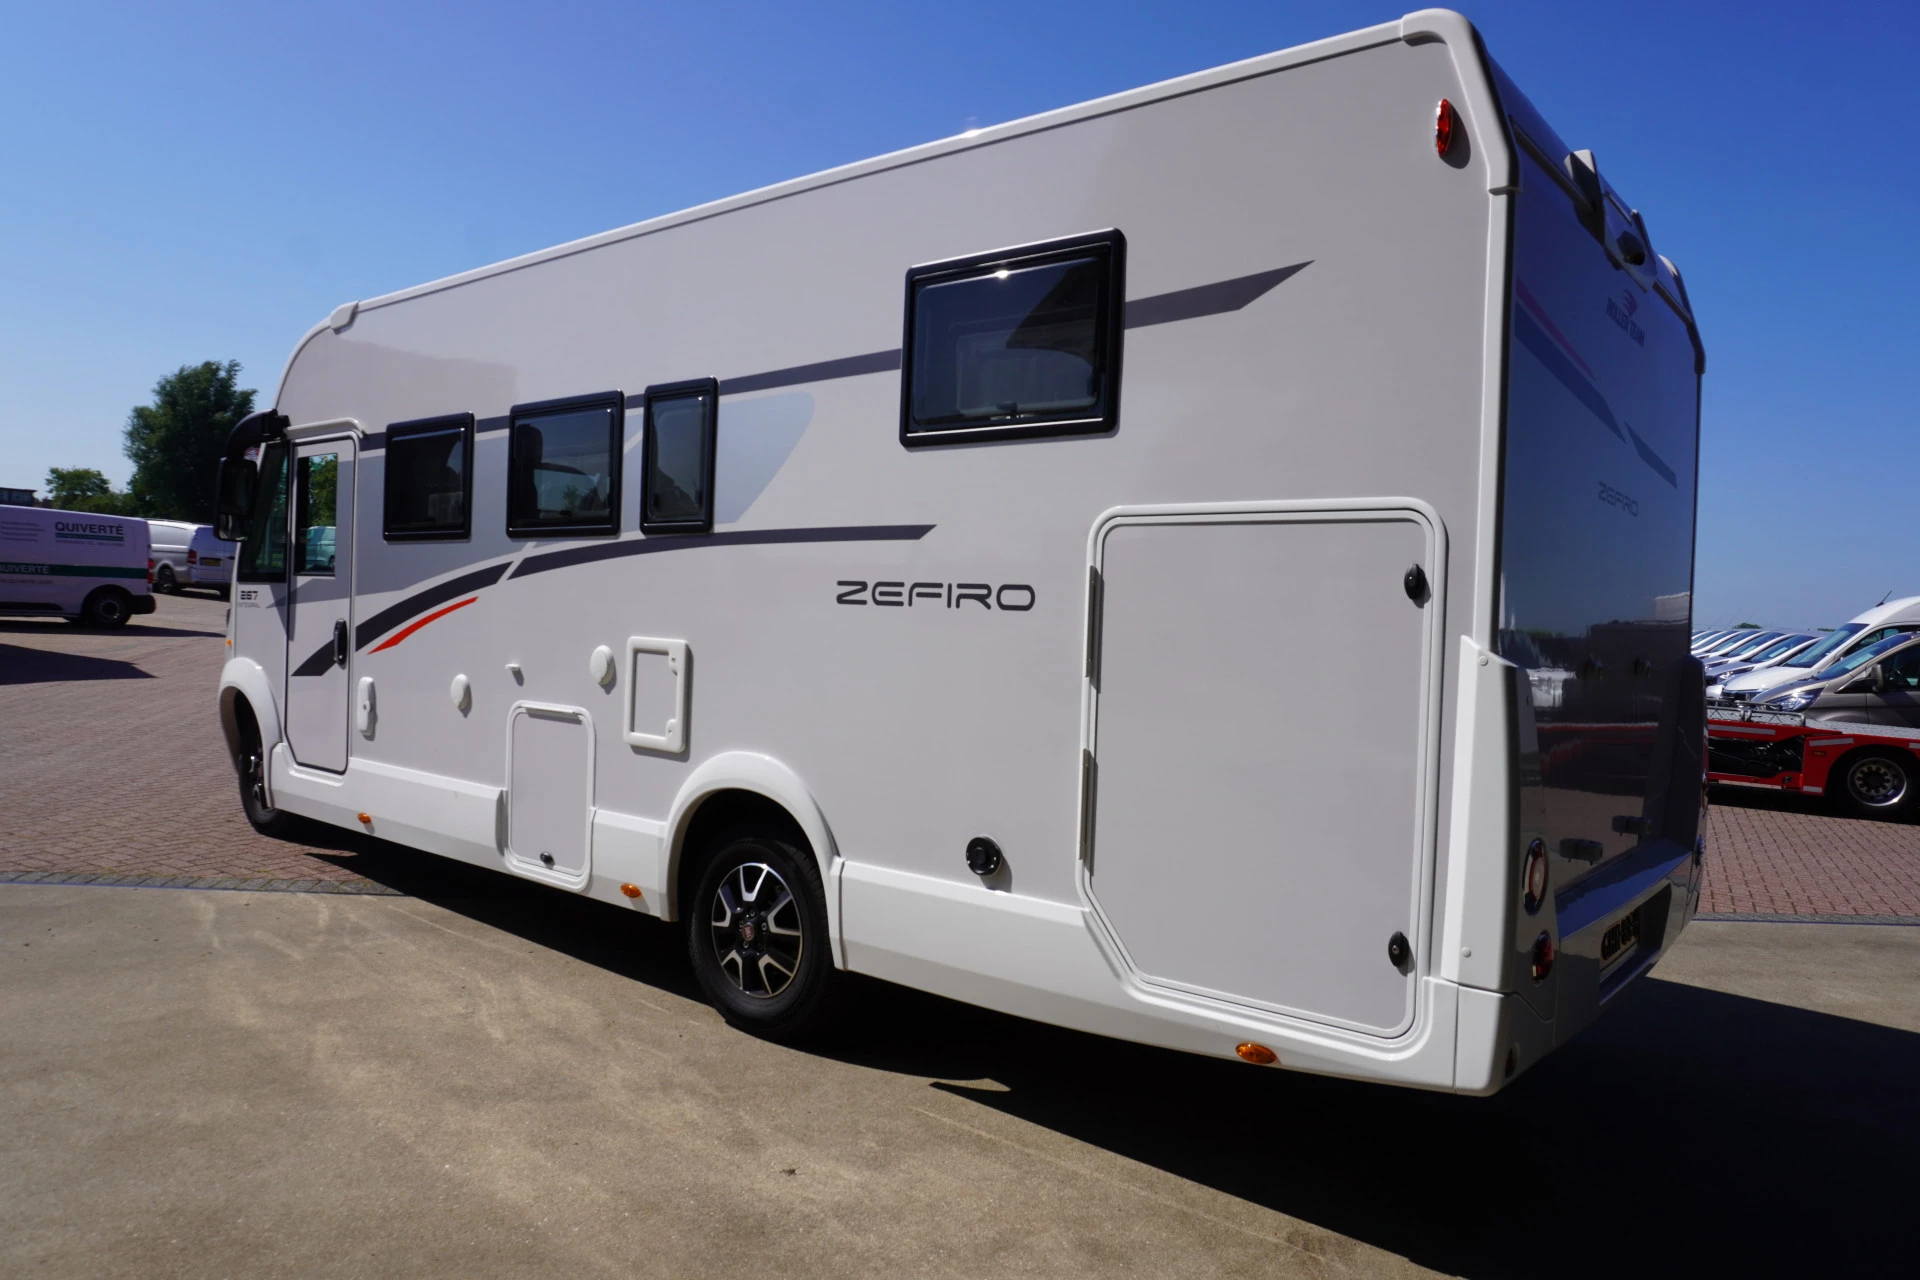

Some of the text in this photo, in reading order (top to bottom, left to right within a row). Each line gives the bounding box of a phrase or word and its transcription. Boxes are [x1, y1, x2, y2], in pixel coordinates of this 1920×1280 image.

[1598, 480, 1639, 518] ZEFIRO
[55, 521, 124, 535] QUIVERTÉ
[836, 580, 1036, 611] ZEFIRO
